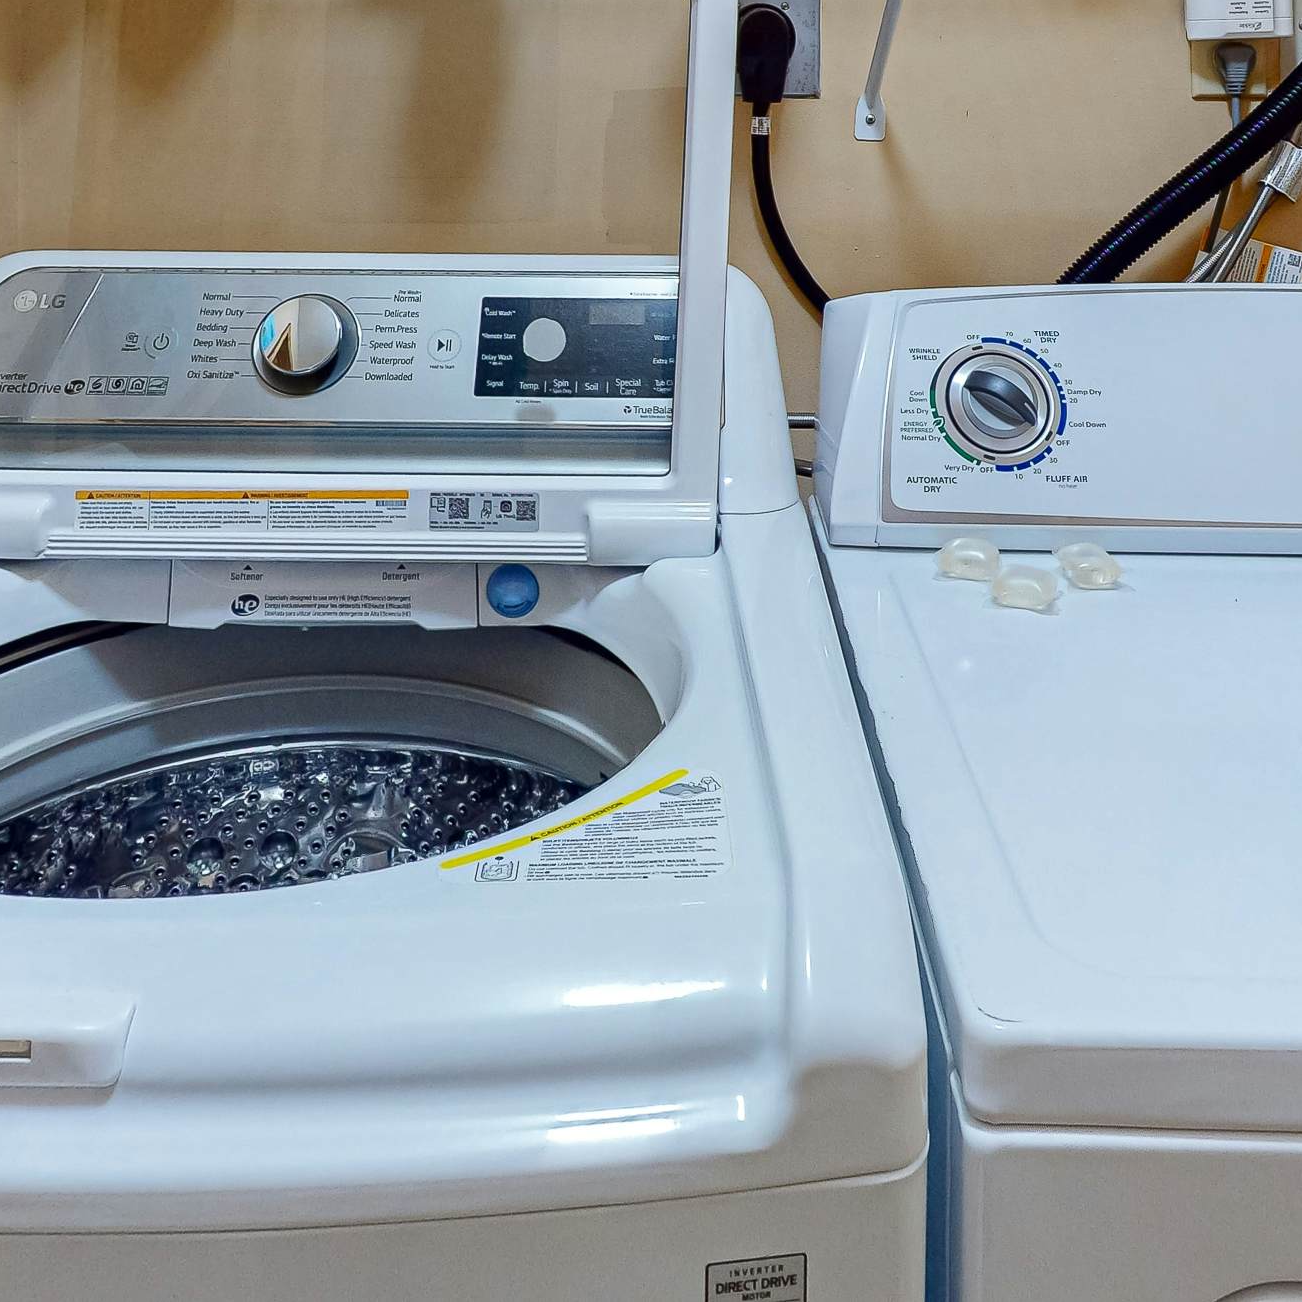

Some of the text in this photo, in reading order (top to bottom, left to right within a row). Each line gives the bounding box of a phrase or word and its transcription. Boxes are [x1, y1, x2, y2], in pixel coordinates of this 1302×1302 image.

[202, 292, 231, 301] Normal
[393, 295, 422, 303] Normal
[40, 294, 66, 309] LG
[199, 308, 244, 318] Heavy Duty
[384, 309, 420, 318] Delicates
[196, 323, 228, 333] Bedding
[193, 338, 236, 348] Deep Wash
[369, 340, 416, 350] Speed Wash
[191, 354, 218, 363] Whites
[370, 356, 414, 366] Waterproof
[187, 370, 201, 379] Oxi
[364, 372, 413, 381] Downloaded
[486, 380, 504, 388] Signal
[553, 378, 569, 388] Spin
[584, 382, 599, 391] Soil
[615, 378, 641, 388] Special
[620, 387, 636, 396] Care
[1067, 388, 1102, 396] Damp Dry
[944, 464, 975, 472] Very Dry
[906, 476, 958, 484] AUTOMATIC
[1045, 475, 1071, 483] FLUFF
[923, 485, 941, 493] DRY
[230, 572, 264, 581] Softener
[382, 571, 420, 582] Detergent
[231, 593, 260, 617] he
[541, 821, 578, 837] CAUTION
[582, 802, 624, 821] ATTENTION
[729, 1264, 784, 1277] INVERTER
[715, 1273, 798, 1295] DIRECT DRIVE
[741, 1291, 771, 1301] MOTOR
